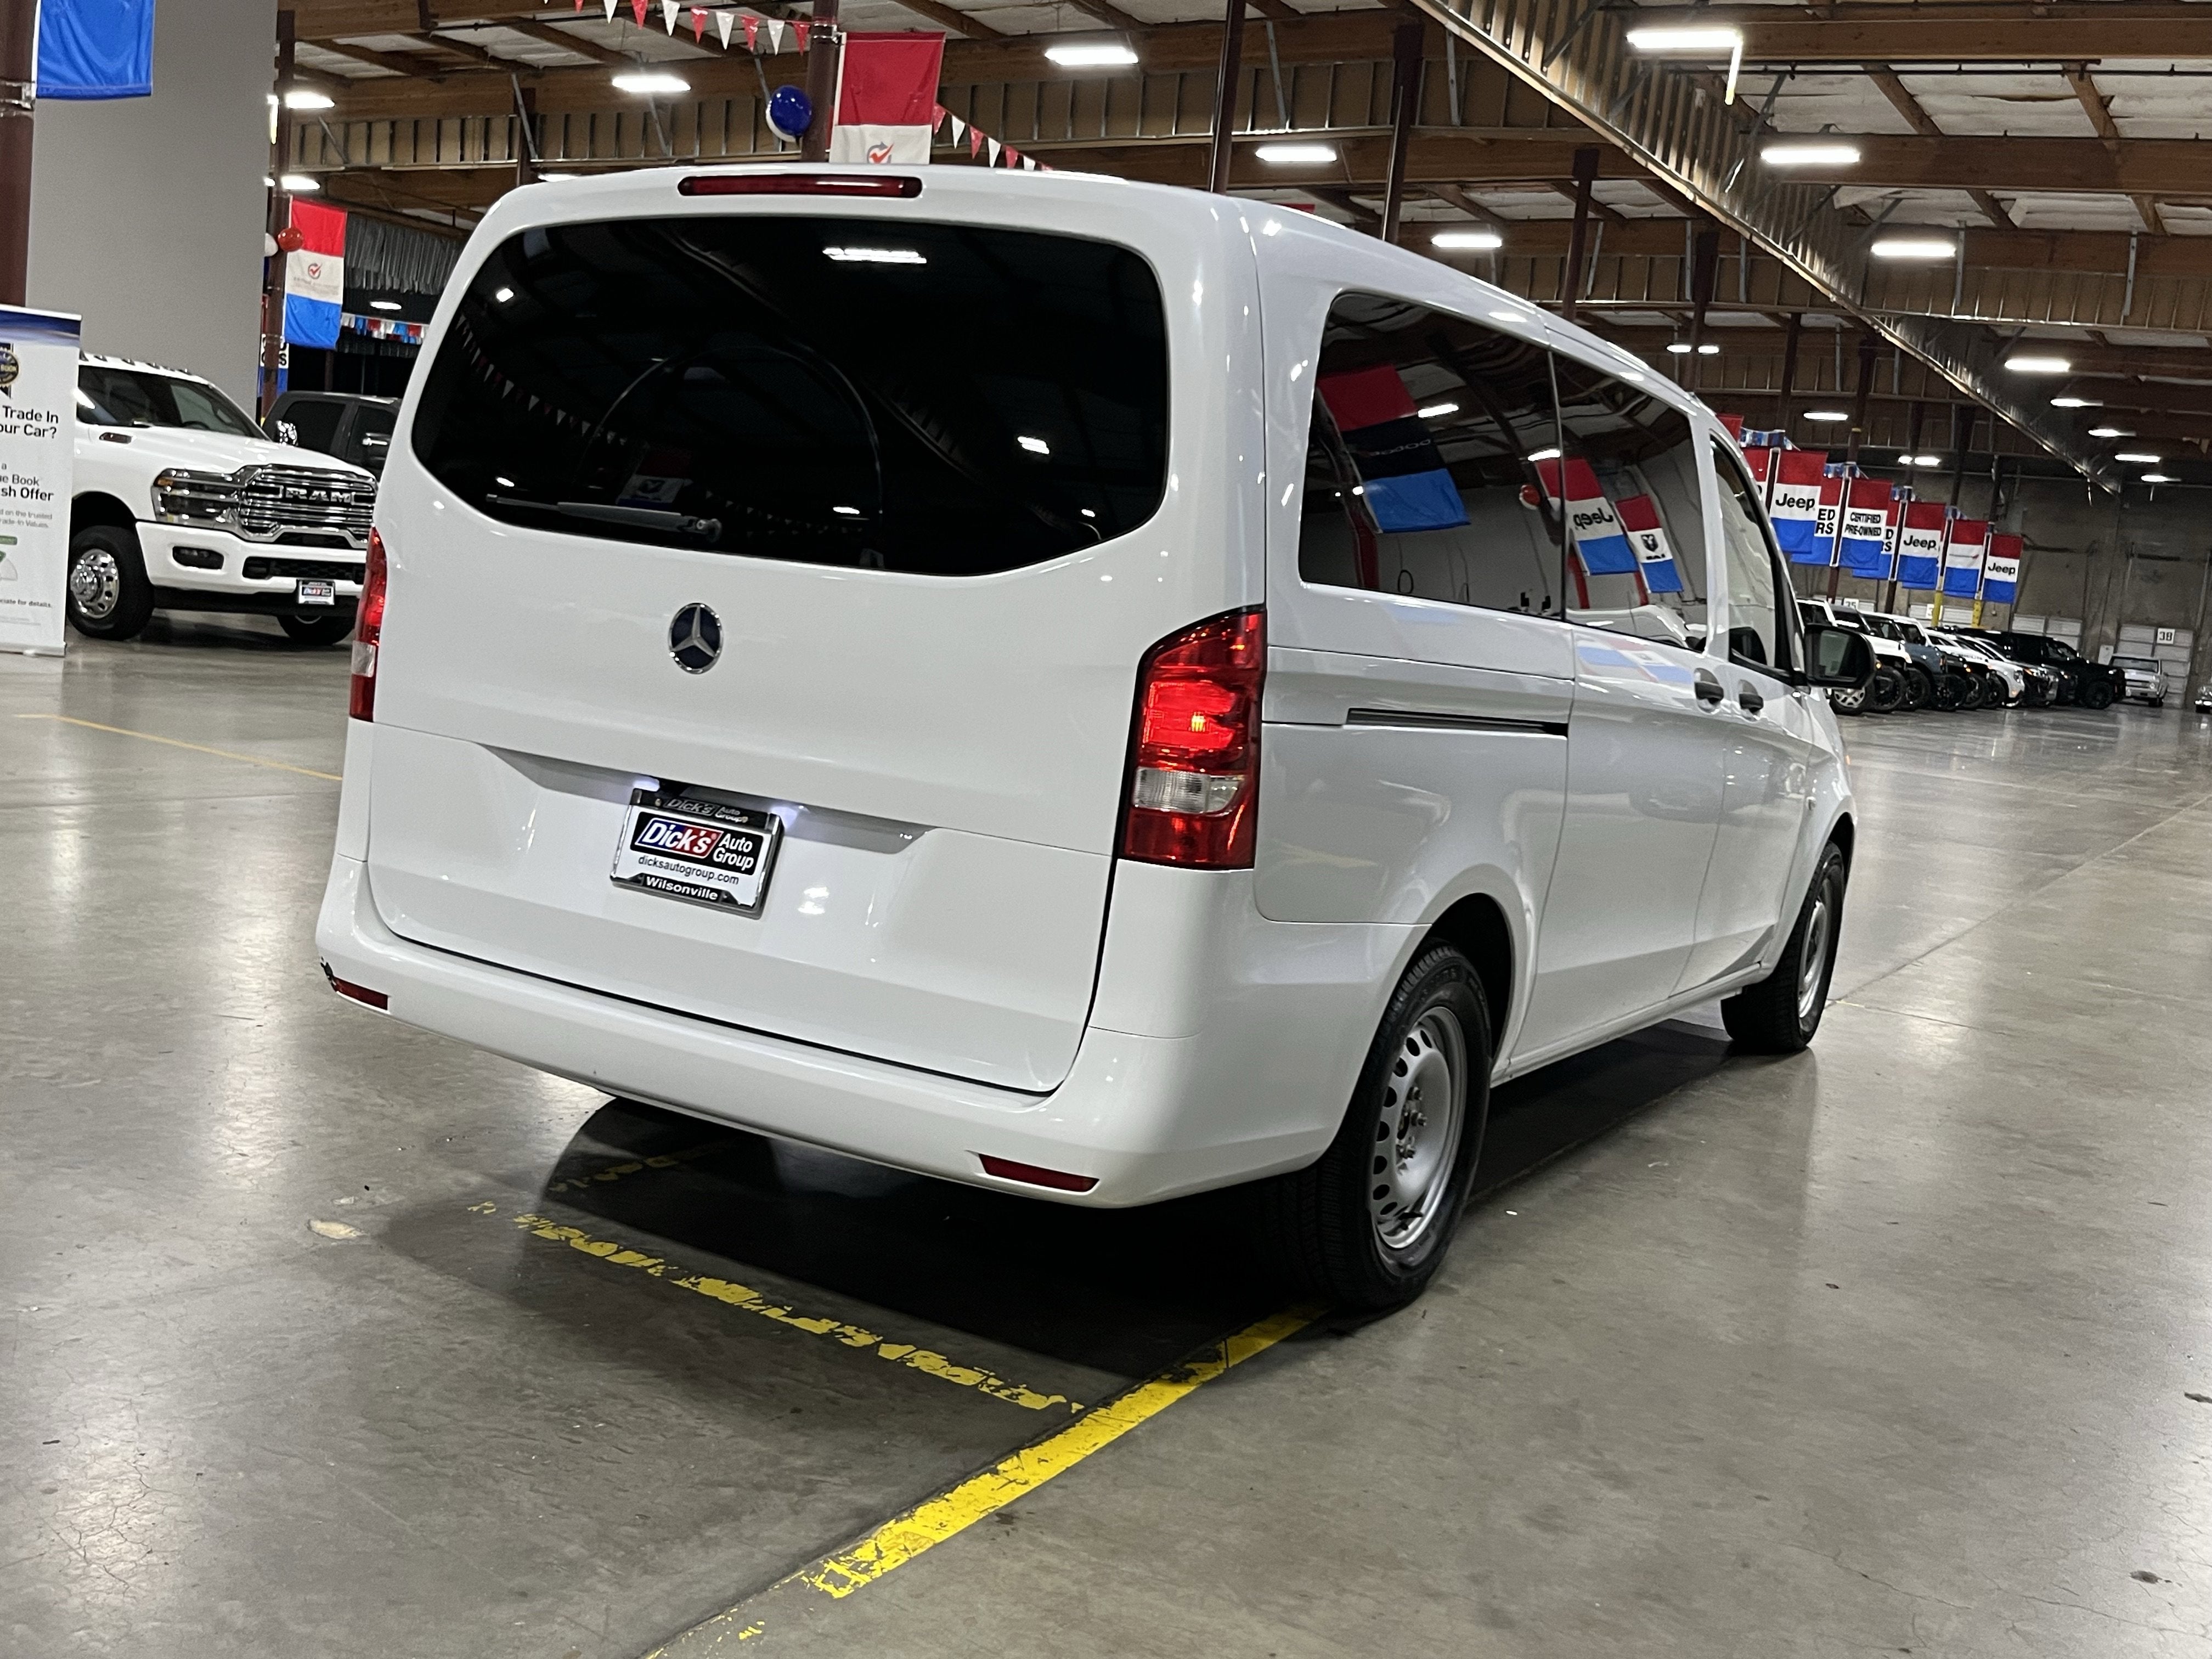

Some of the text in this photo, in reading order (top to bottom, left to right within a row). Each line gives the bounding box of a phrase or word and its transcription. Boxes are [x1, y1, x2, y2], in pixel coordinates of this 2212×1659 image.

[2, 405, 59, 424] Trade In
[0, 424, 57, 439] our Car?
[12, 474, 40, 487] Book
[1, 485, 54, 501] sh Offer
[285, 487, 351, 503] RAM
[1775, 493, 1815, 511] Jeep
[1818, 508, 1836, 521] ED
[1850, 511, 1881, 524] CERTIFIED
[1815, 522, 1834, 534] RS
[1844, 524, 1882, 536] PRE-OWNED
[1903, 535, 1937, 550] Jeep
[1988, 562, 2016, 576] Jeep
[667, 799, 715, 814] Dick's
[720, 806, 741, 816] Auto
[642, 822, 712, 854] Dick's
[718, 833, 753, 853] Auto
[713, 847, 754, 871] Group
[638, 855, 740, 885] dicksautogroup.com
[646, 876, 718, 900] Wilsonville
